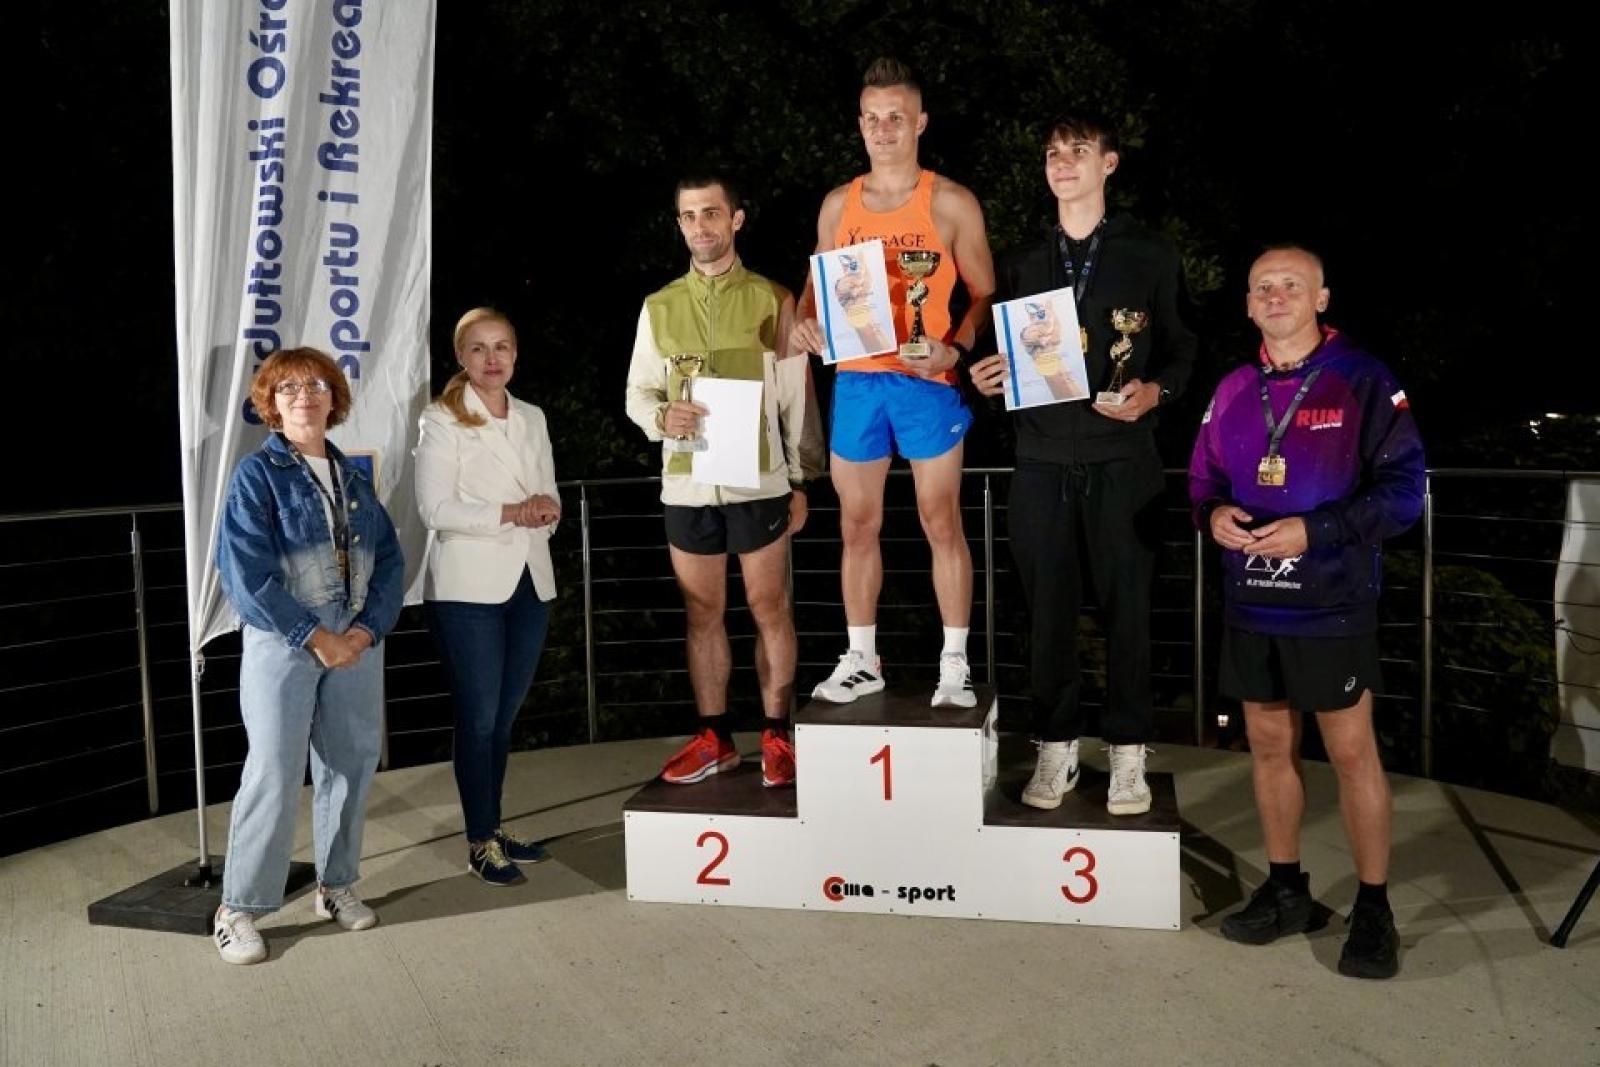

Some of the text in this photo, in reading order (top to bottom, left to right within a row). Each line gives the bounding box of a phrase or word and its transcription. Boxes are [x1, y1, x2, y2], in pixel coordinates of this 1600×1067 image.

[317, 190, 359, 204] i
[1296, 408, 1343, 427] RUN
[869, 744, 892, 801] 1
[695, 831, 731, 886] 2
[1061, 846, 1099, 904] 3
[898, 885, 956, 904] sport
